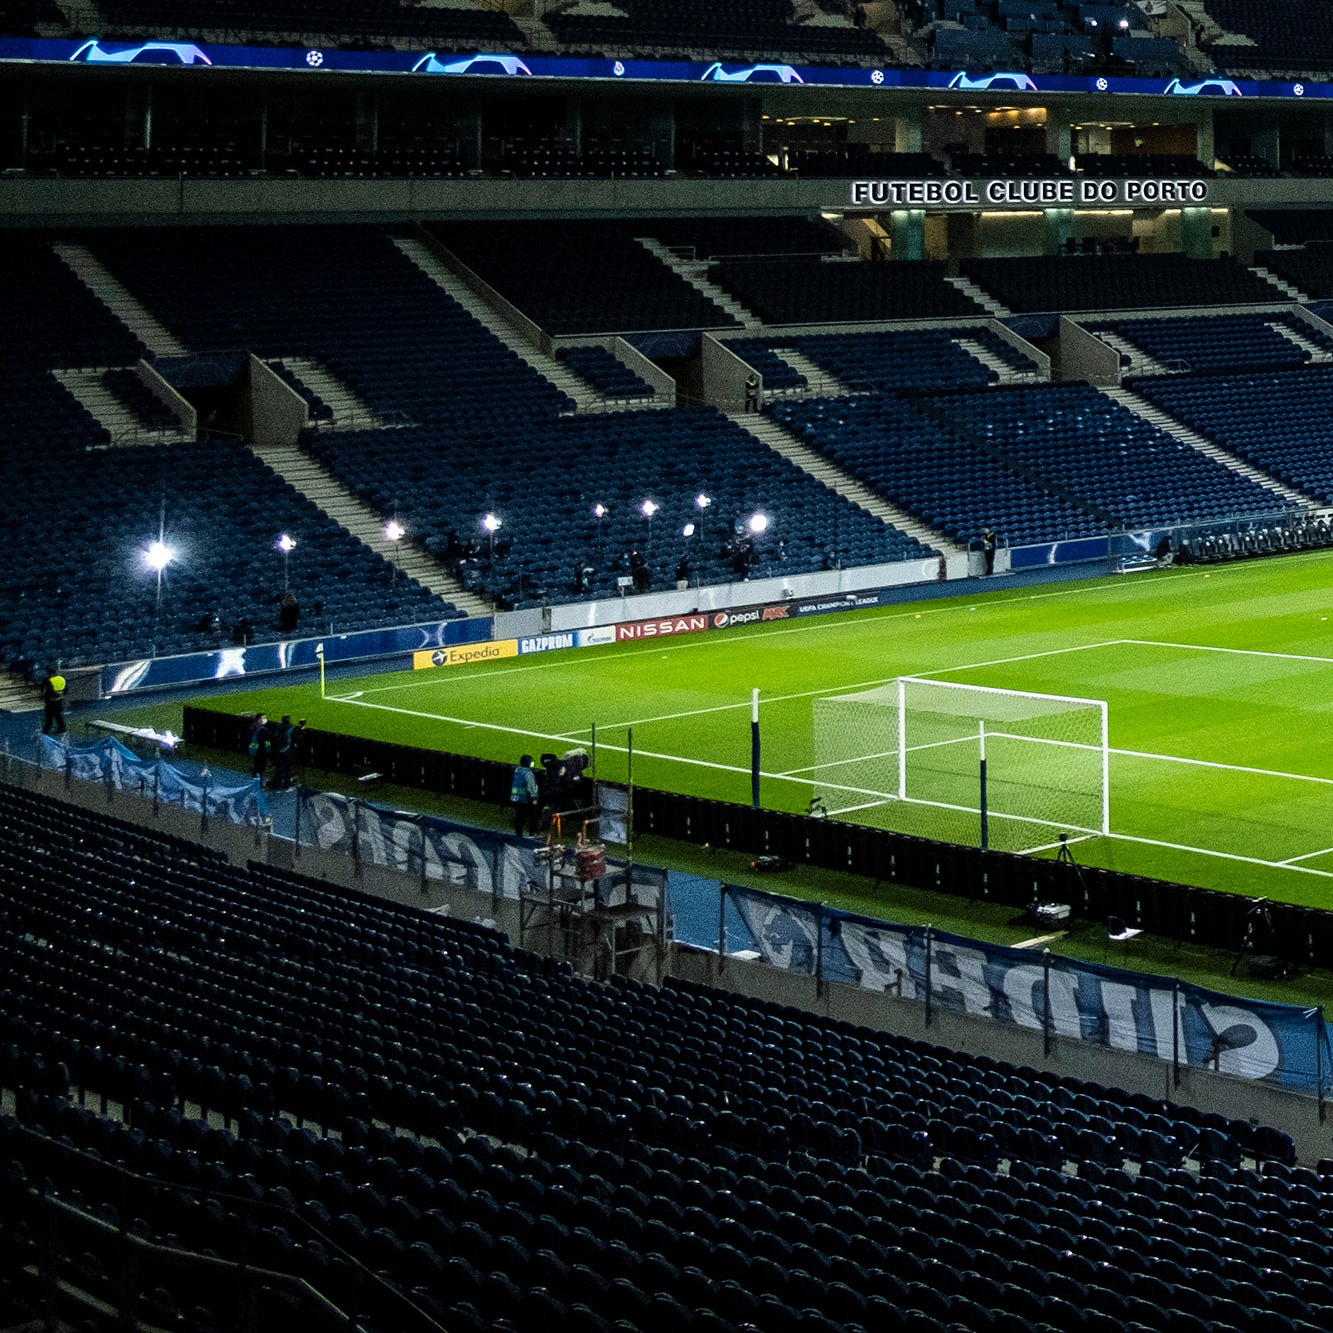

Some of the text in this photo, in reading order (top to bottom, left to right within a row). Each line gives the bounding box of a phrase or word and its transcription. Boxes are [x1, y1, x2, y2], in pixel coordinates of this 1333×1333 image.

[853, 180, 1208, 204] FUTEBOL CLUBE DO PORTO
[729, 609, 761, 626] pepsi
[799, 604, 817, 613] UEFA
[619, 616, 705, 640] NISSAN
[521, 633, 573, 654] GAZPROM
[450, 646, 500, 663] Expedia
